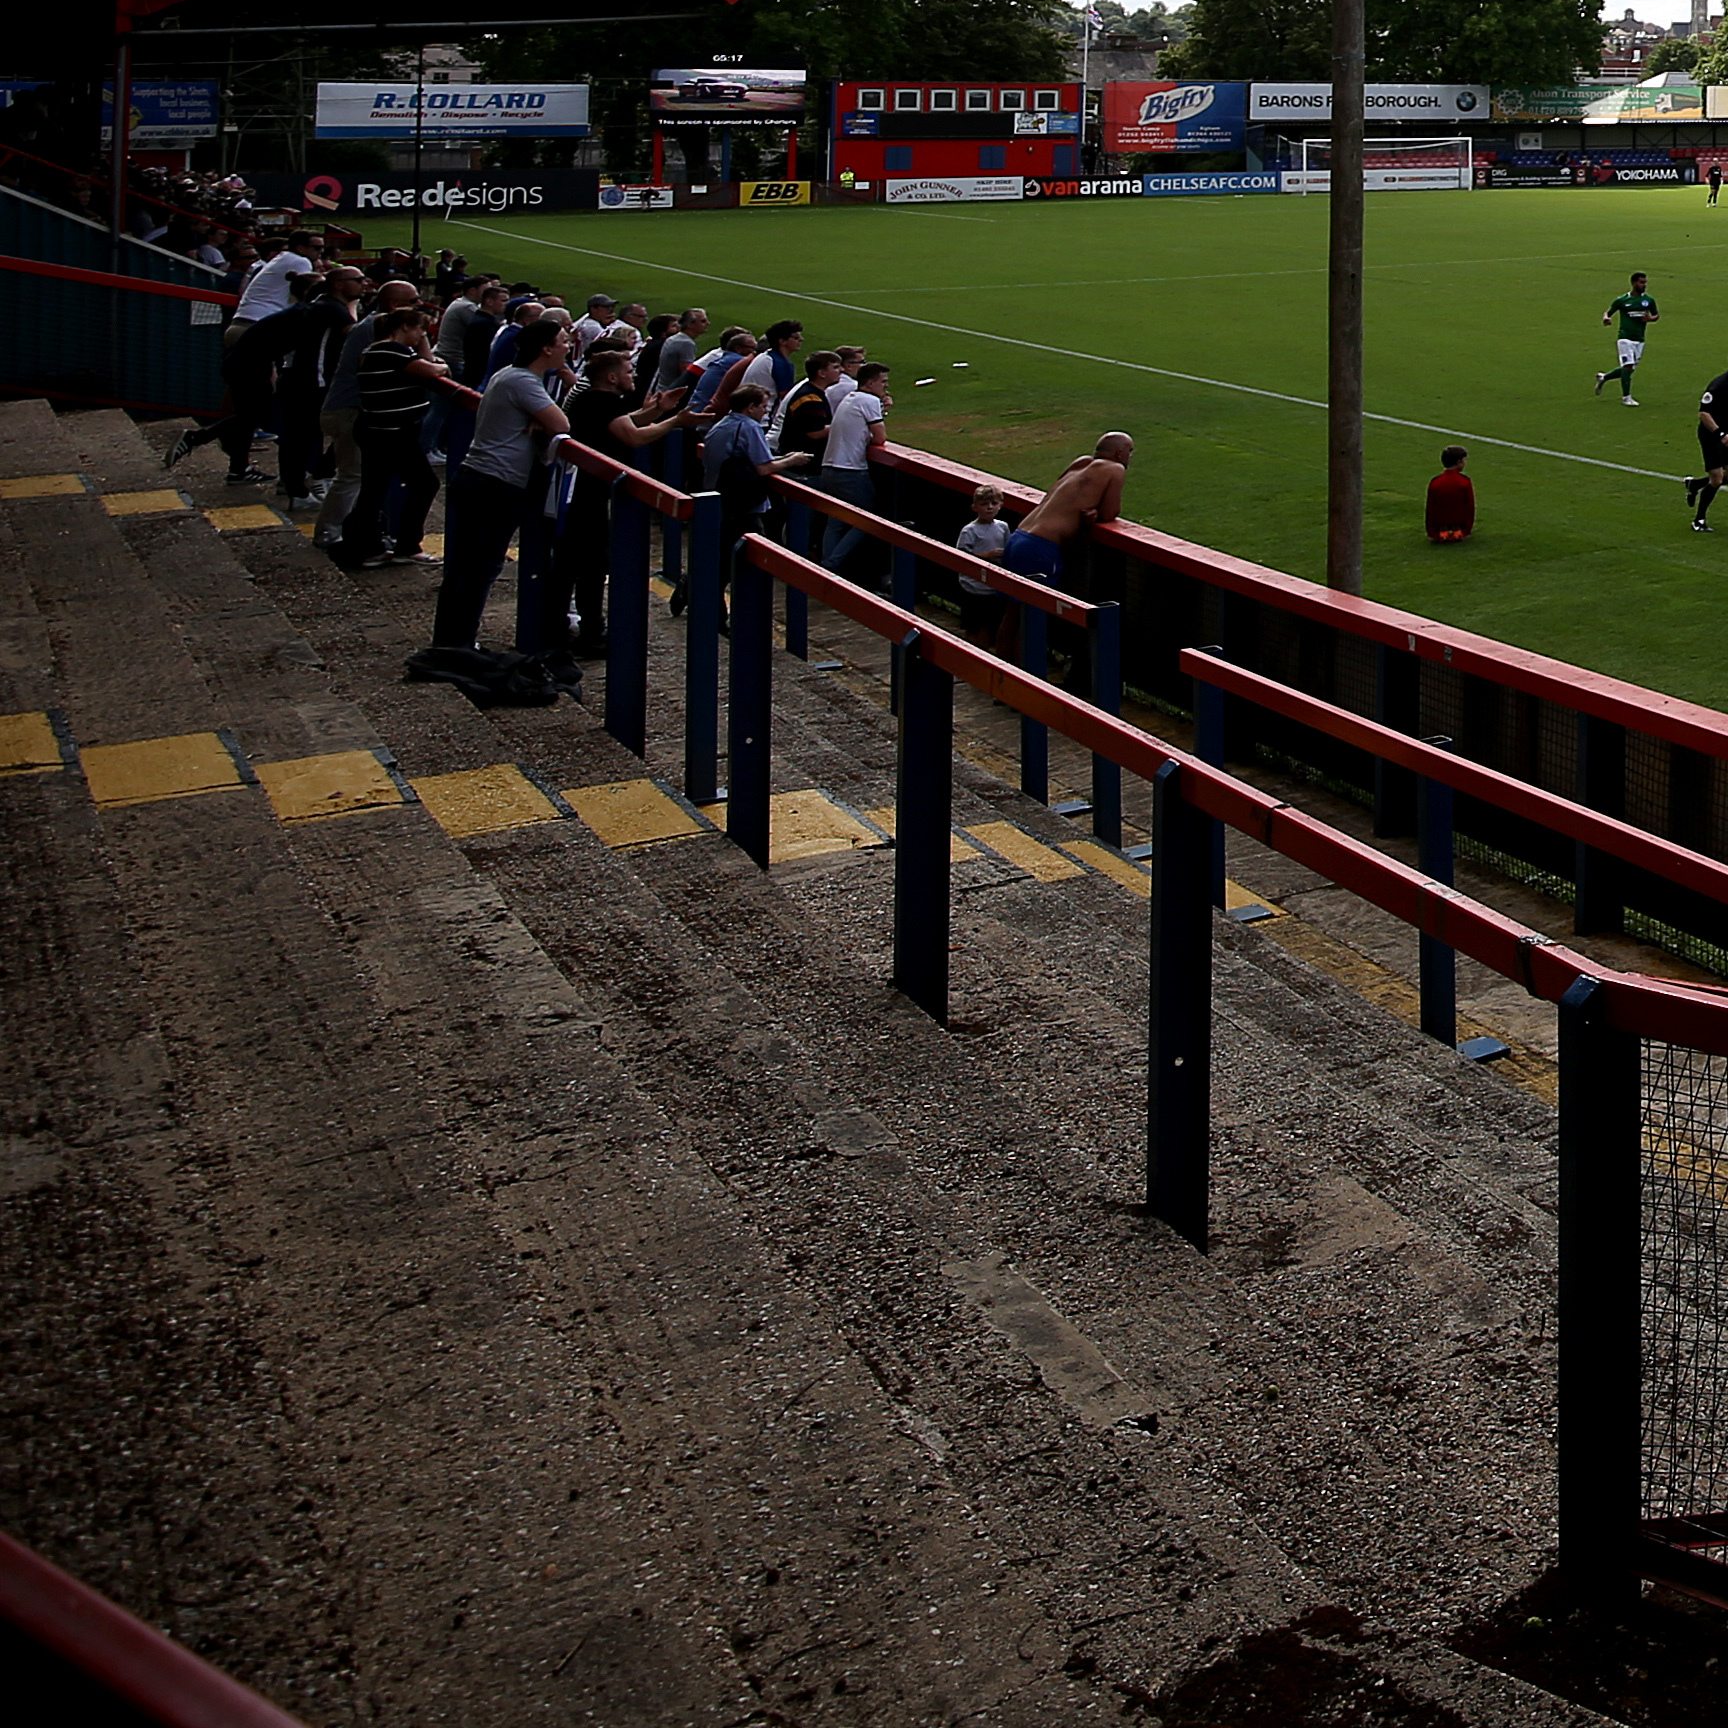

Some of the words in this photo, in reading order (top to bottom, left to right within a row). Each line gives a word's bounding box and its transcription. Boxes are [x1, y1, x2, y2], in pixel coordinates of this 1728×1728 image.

[373, 92, 546, 109] R.COLLARD
[1613, 88, 1650, 99] Service
[1259, 96, 1323, 107] BARONS
[1327, 96, 1441, 107] FBOROUGH.
[370, 111, 428, 119] Demolish
[440, 111, 489, 120] Dispose
[500, 111, 545, 120] Recycle
[1615, 168, 1679, 181] YOKOHAMA
[889, 182, 918, 200] JOHN
[919, 181, 963, 198] GUNNER
[1041, 179, 1143, 195] vanarama
[1149, 176, 1276, 191] CHELSEAFC.COM
[357, 181, 543, 211] Readesigns
[750, 183, 800, 200] EBB
